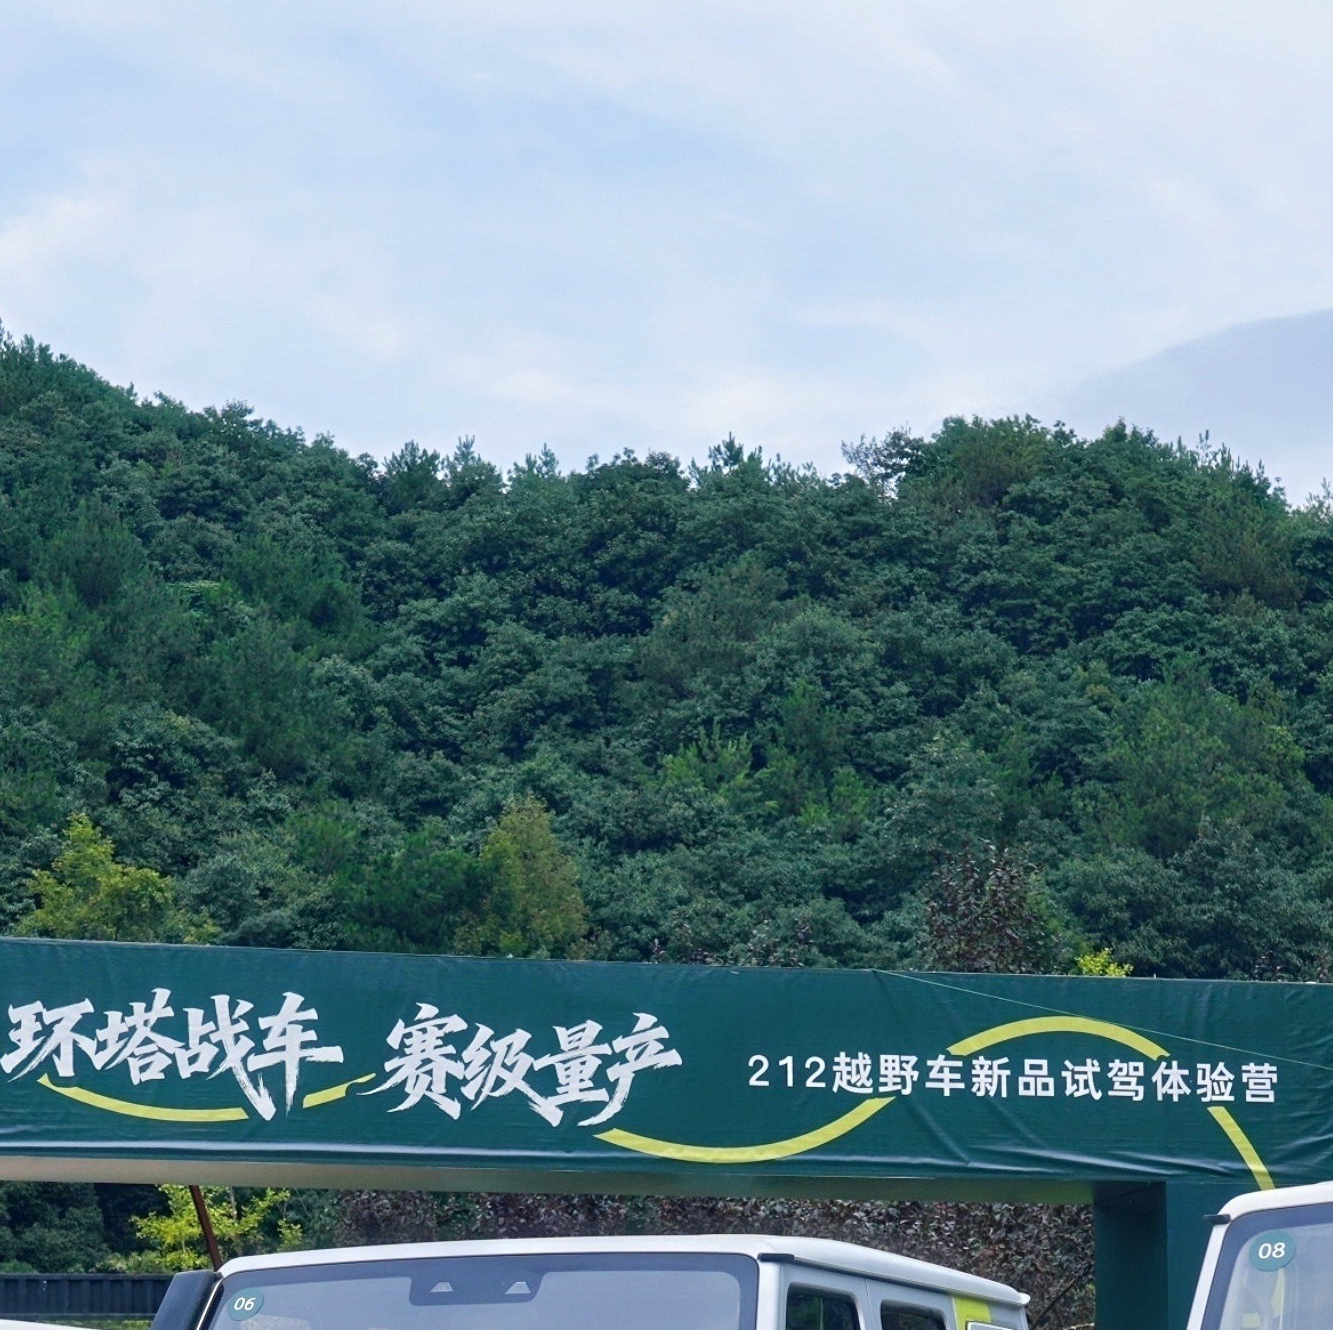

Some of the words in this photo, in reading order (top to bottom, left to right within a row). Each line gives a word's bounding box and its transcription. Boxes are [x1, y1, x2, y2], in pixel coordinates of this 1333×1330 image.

[0, 987, 344, 1121] 环塔战车
[356, 1002, 683, 1127] 赛级量产
[747, 1051, 1279, 1103] 212越野车新品试驾体验营
[1258, 1242, 1286, 1259] 08
[233, 1297, 257, 1311] 06
